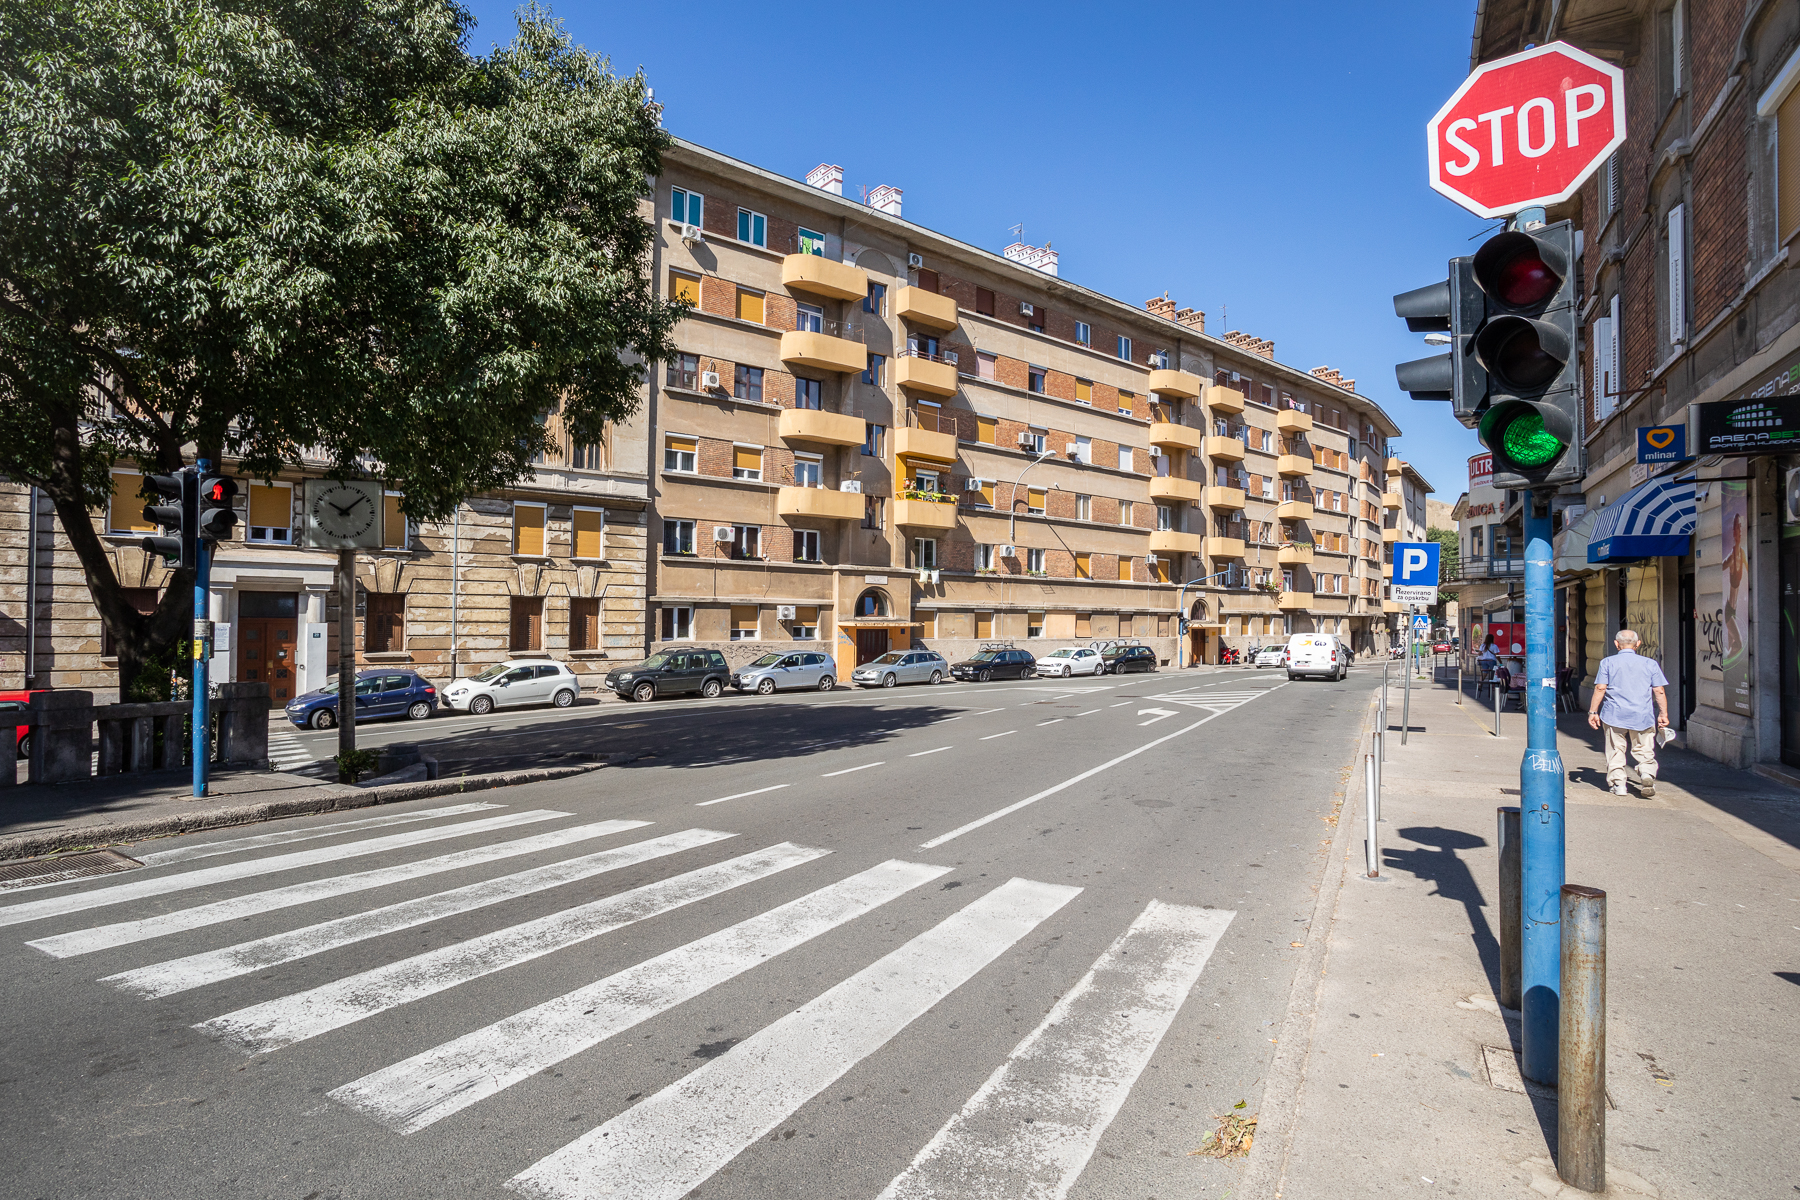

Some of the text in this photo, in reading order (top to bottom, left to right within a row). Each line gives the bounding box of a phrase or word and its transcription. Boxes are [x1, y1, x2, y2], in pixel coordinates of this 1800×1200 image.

[1445, 83, 1606, 177] STOP
[1750, 362, 1800, 399] ARENAB
[1645, 451, 1677, 460] mlinar
[1402, 548, 1428, 580] P
[1395, 587, 1432, 596] Rezervirano
